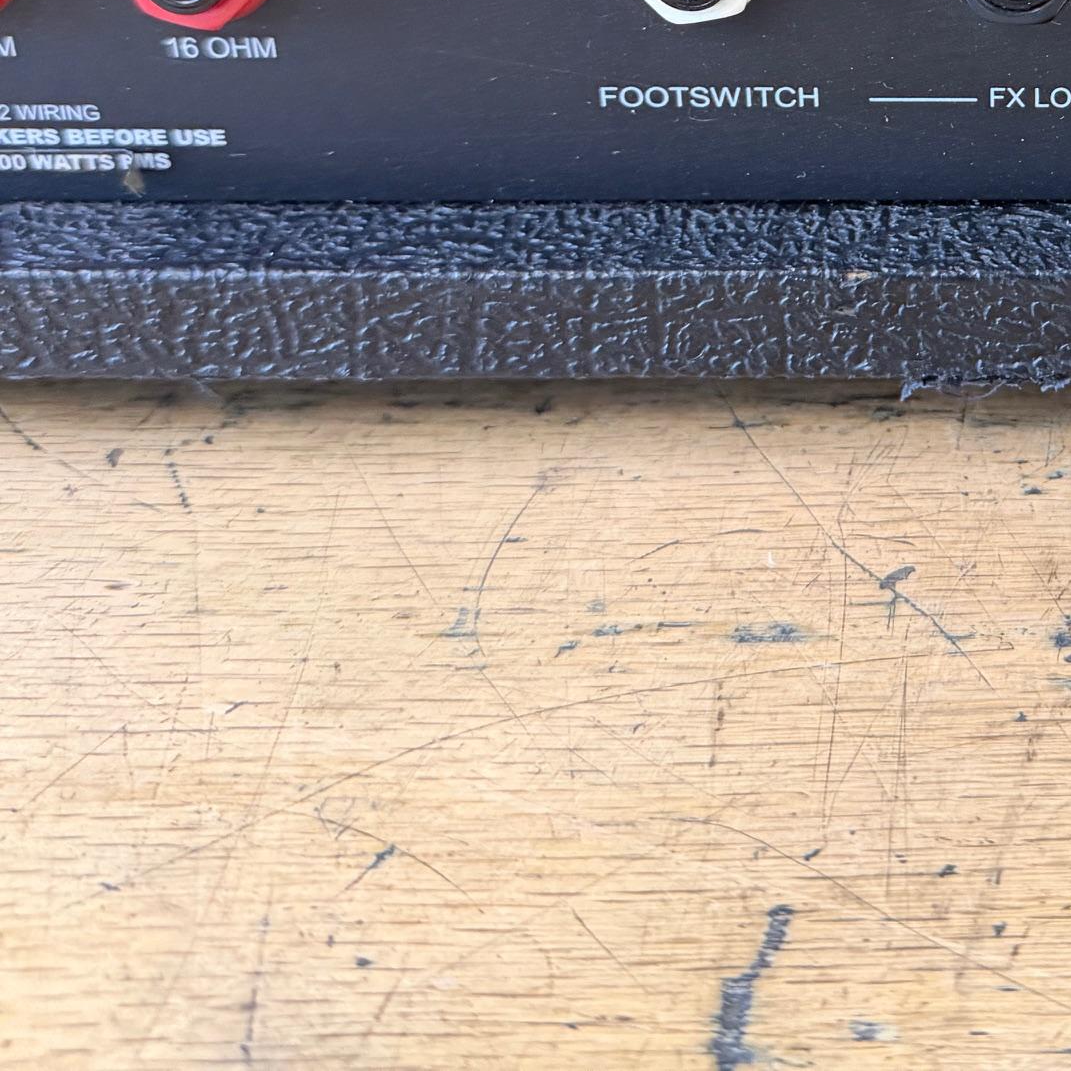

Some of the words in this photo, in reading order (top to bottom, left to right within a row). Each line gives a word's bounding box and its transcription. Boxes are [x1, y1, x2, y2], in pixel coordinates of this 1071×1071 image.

[163, 36, 200, 58] 16
[202, 36, 278, 58] OHM
[599, 86, 820, 109] FOOTSWITCH
[989, 87, 1026, 109] FX
[0, 104, 11, 121] 2
[14, 104, 101, 121] WIRING
[63, 128, 169, 146] BEFORE
[171, 128, 228, 147] USE
[29, 153, 115, 170] WATTS
